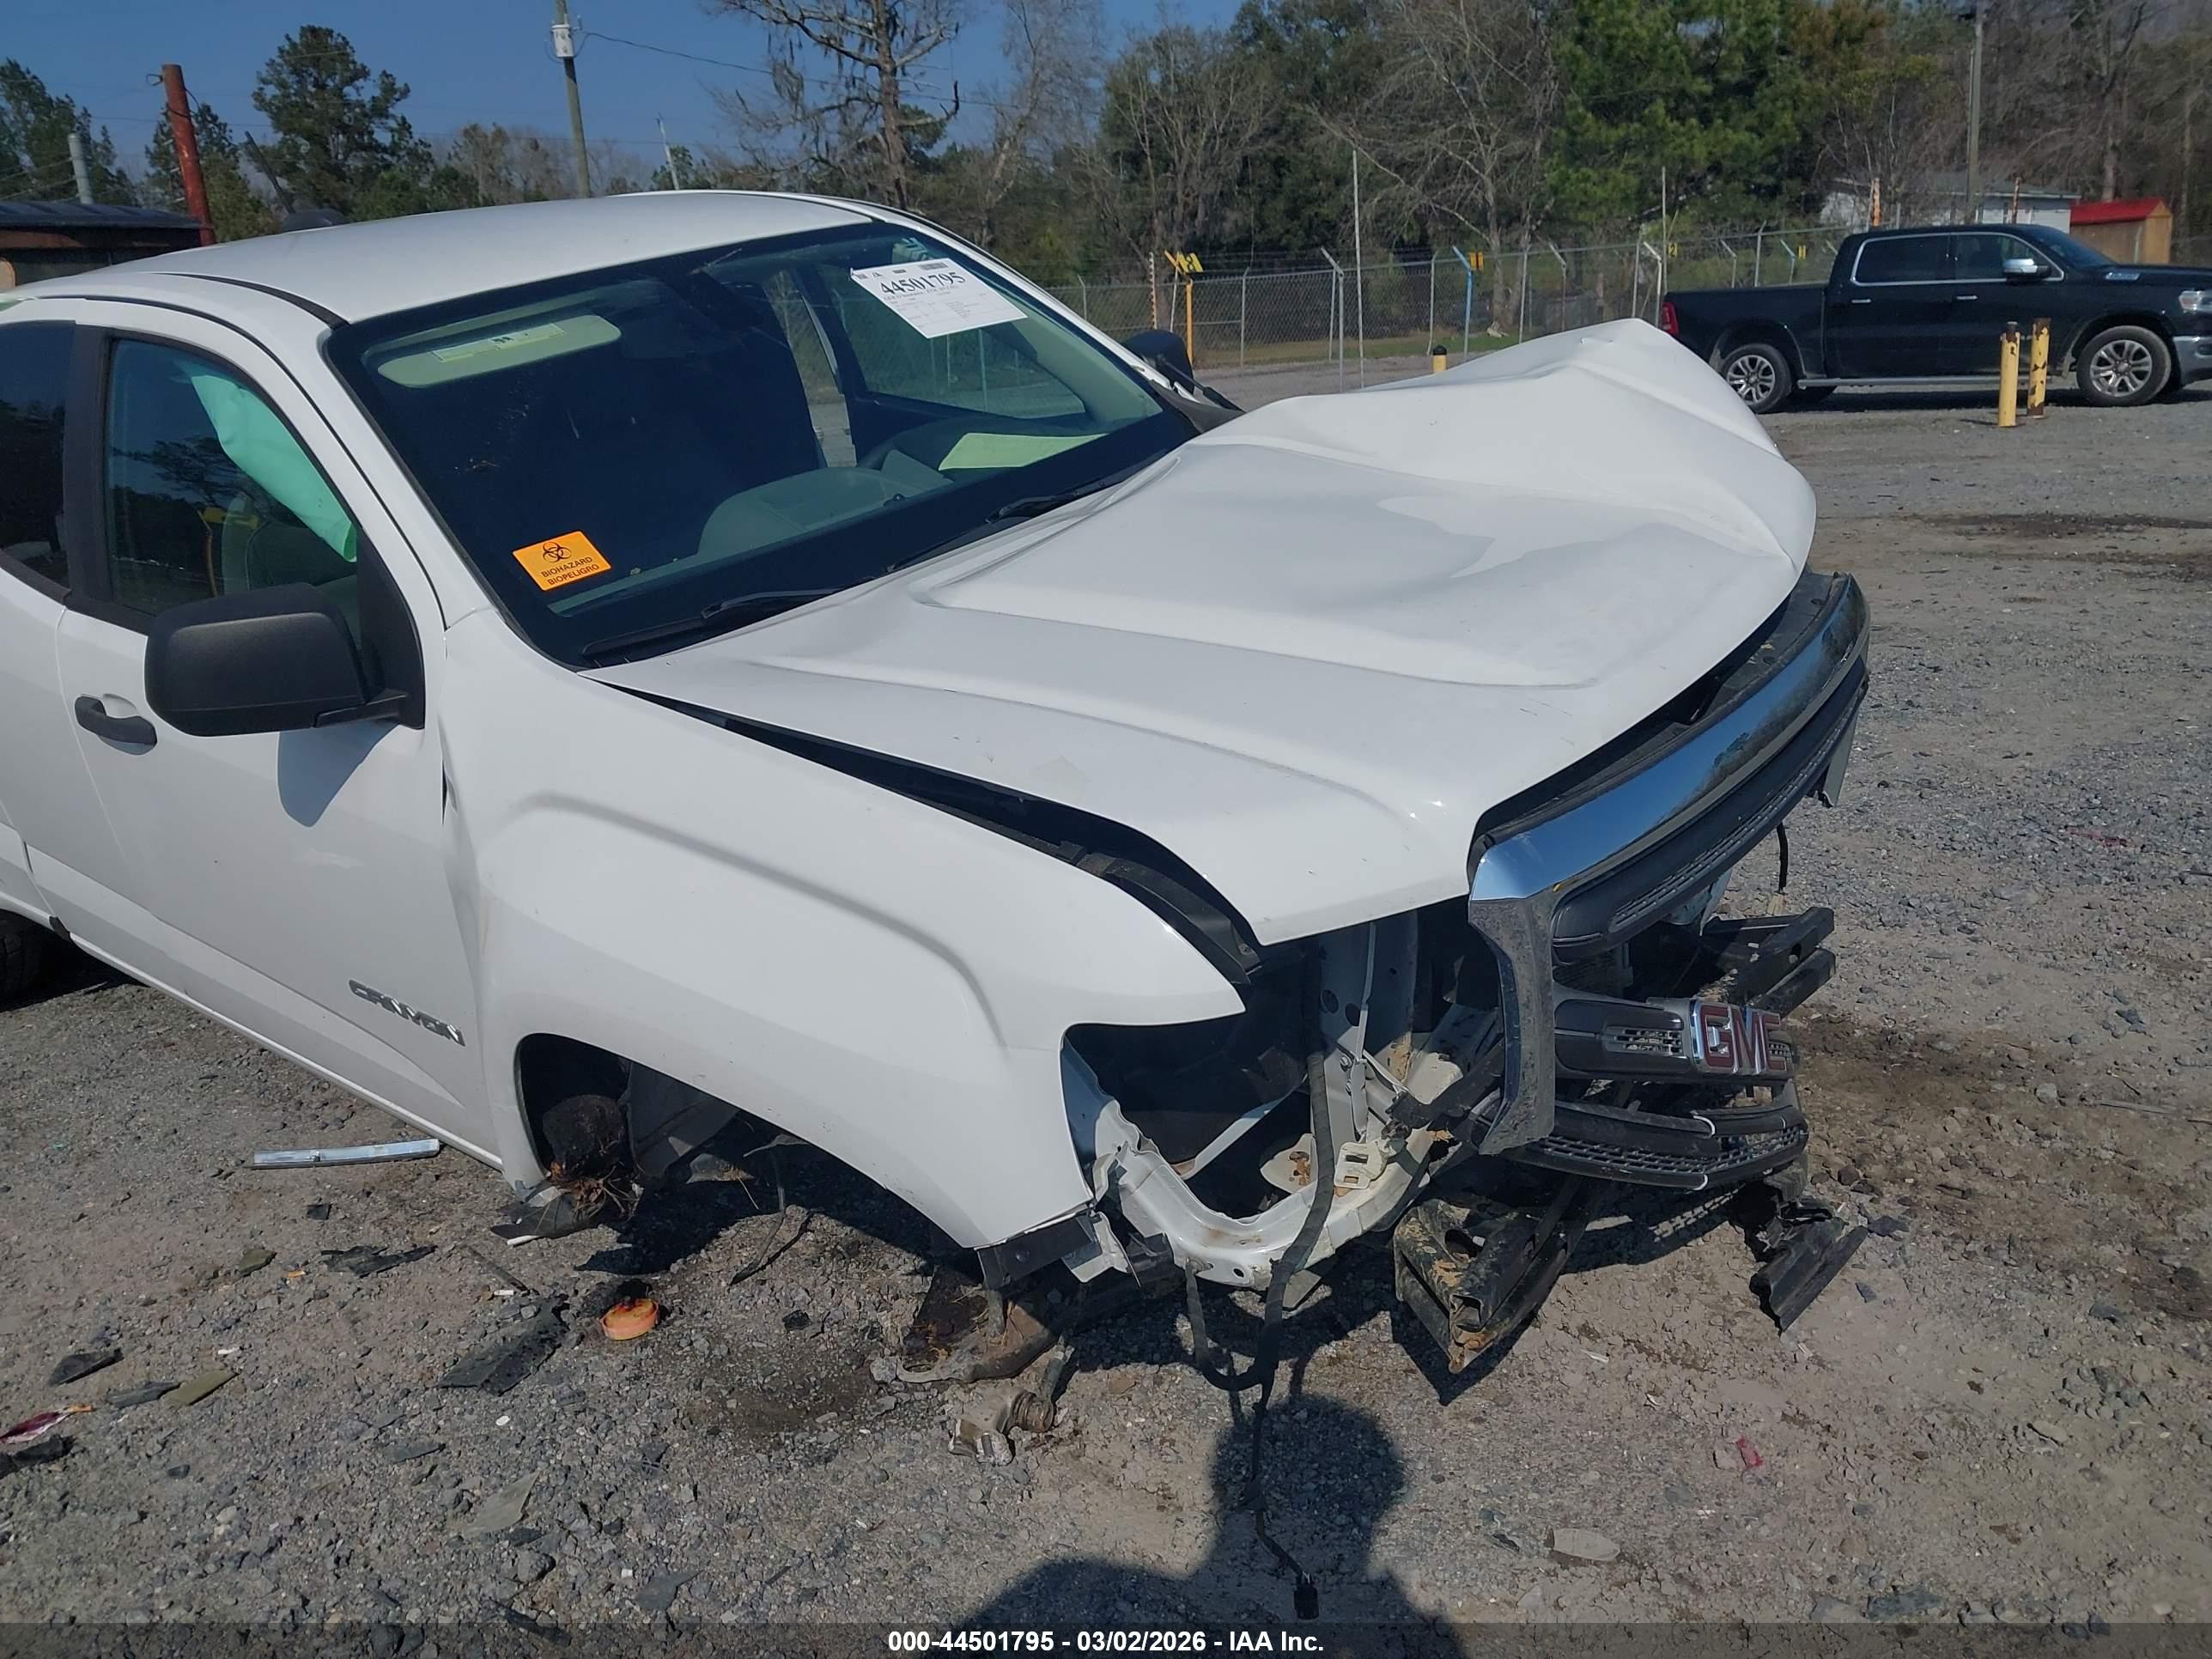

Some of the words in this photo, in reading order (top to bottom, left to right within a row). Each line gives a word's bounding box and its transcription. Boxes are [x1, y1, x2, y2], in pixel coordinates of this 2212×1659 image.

[880, 272, 965, 295] 44501795
[541, 556, 592, 578] BIOHAZARD
[547, 563, 599, 585] BIOPELIGRO
[1693, 999, 1788, 1073] GMC
